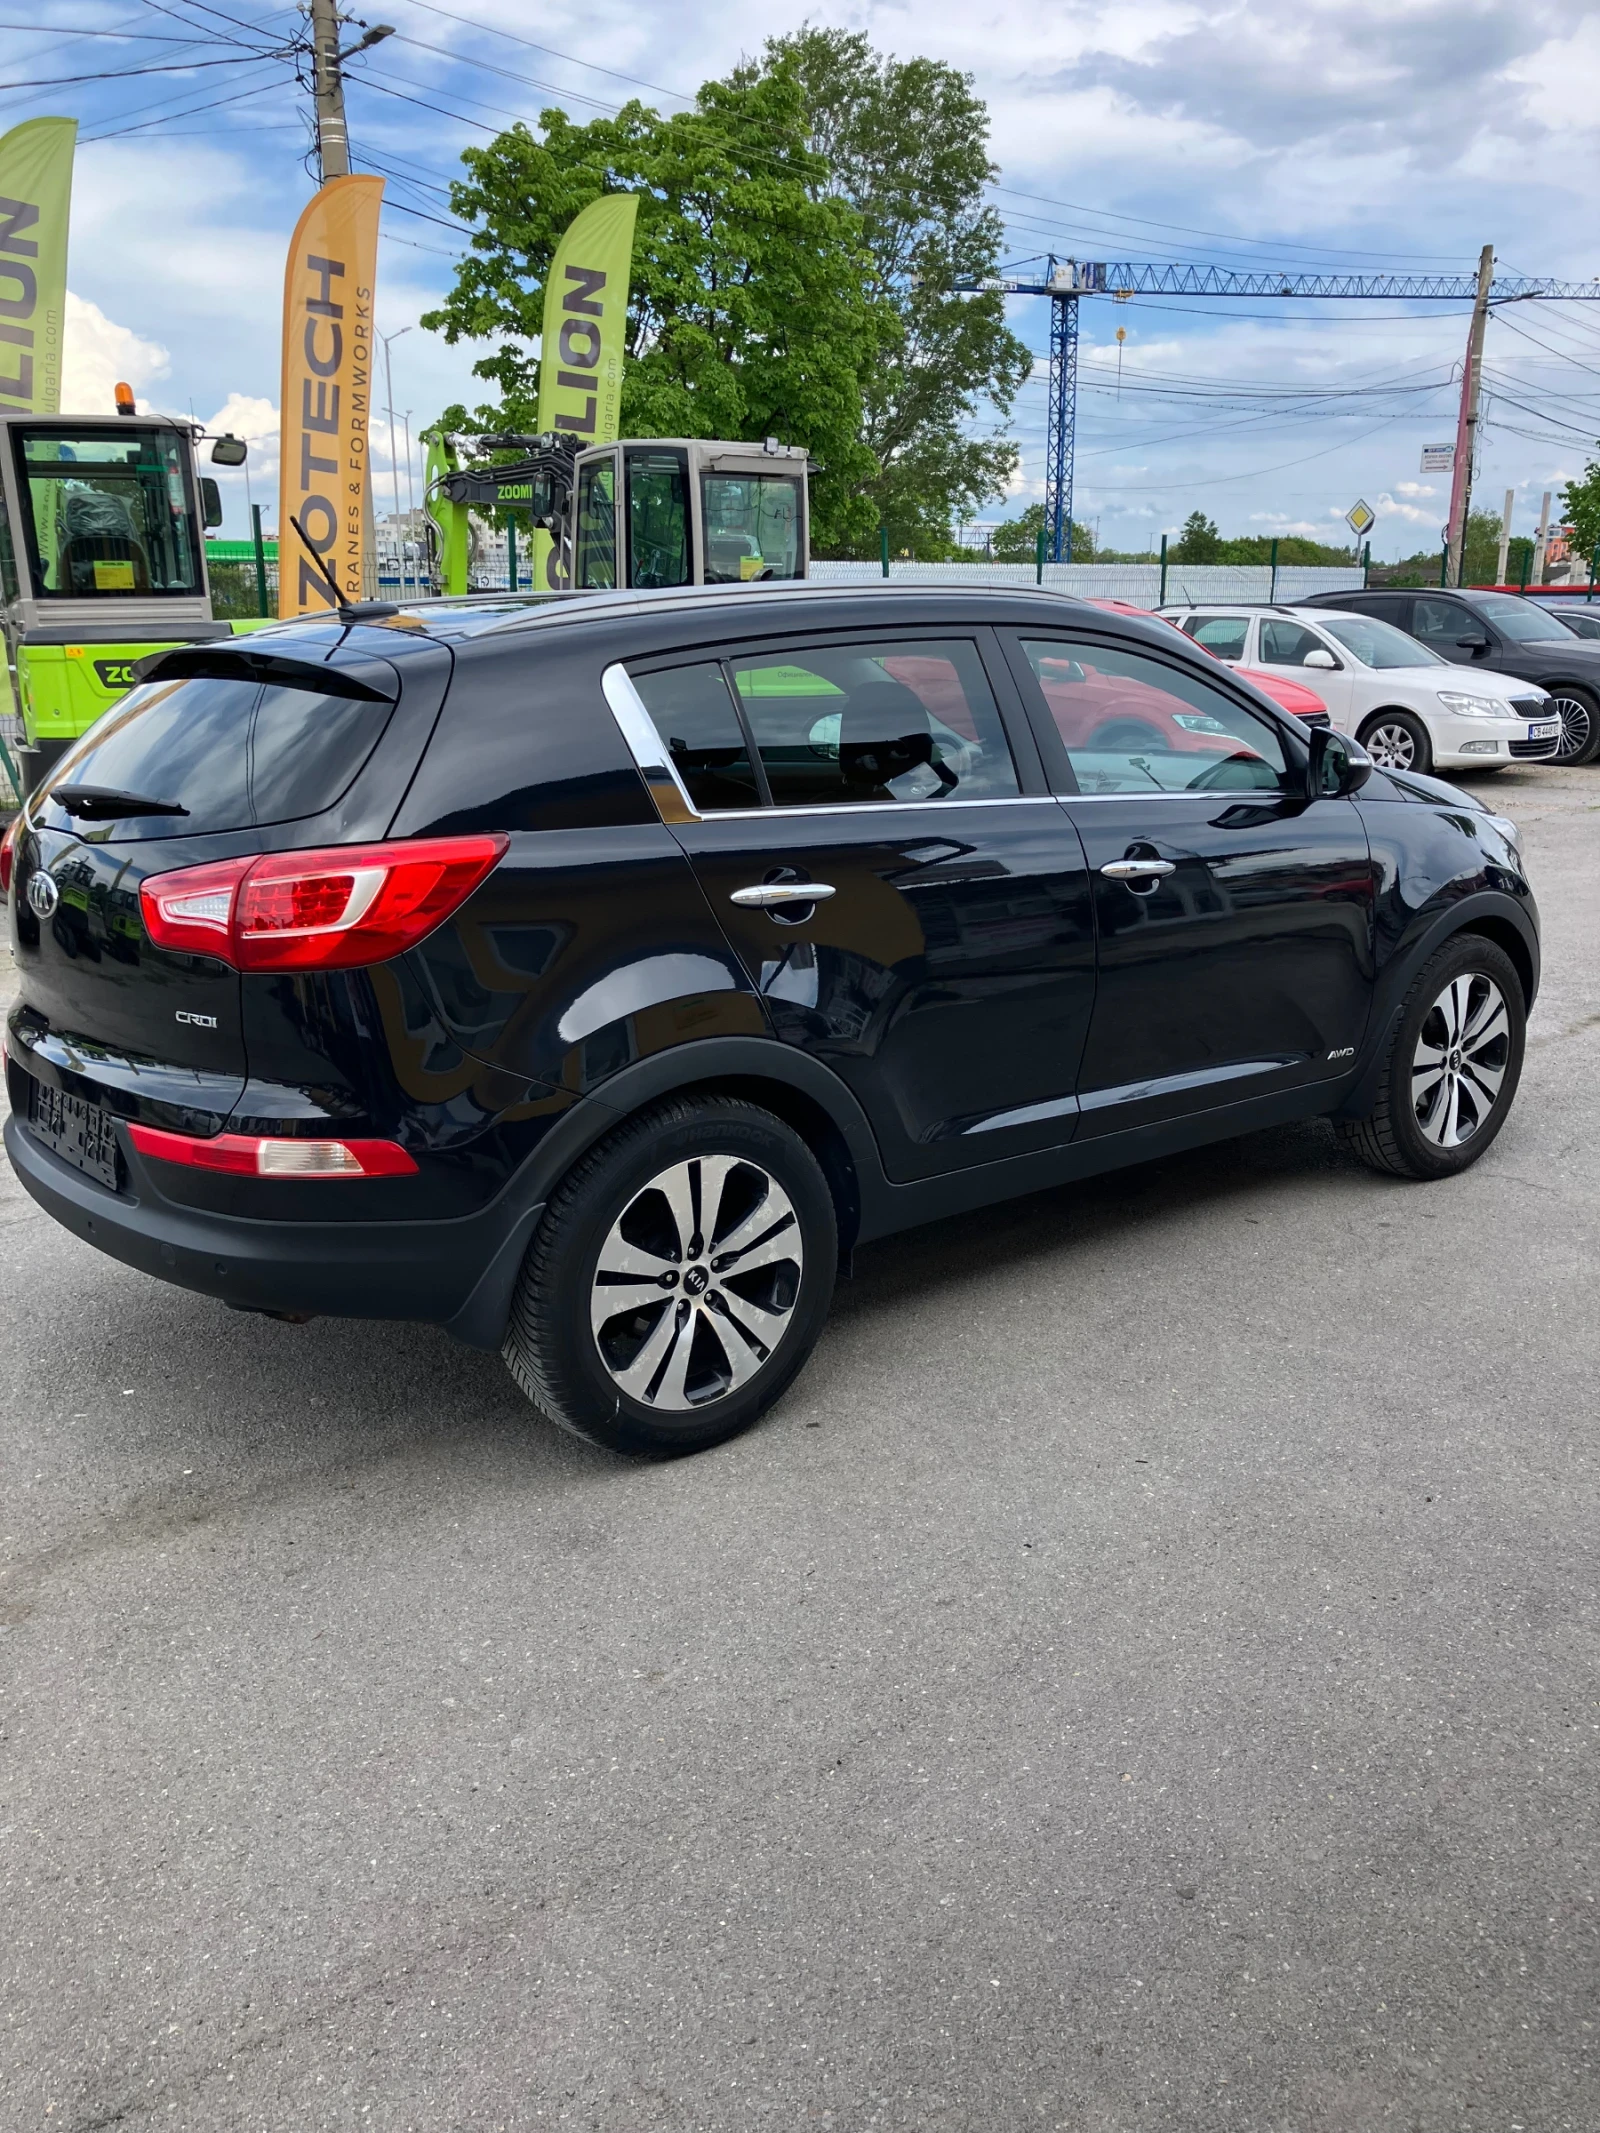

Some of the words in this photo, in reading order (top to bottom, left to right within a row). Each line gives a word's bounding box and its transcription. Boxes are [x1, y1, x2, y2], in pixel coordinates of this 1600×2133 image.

[0, 196, 40, 414] LION
[554, 265, 607, 434] LION
[350, 286, 371, 470] FORMWORKS
[603, 358, 617, 443] ulgaria.com
[299, 254, 345, 609] ZOTECH
[349, 482, 361, 495] &
[347, 506, 360, 602] RANES
[105, 666, 135, 683] ZO
[1326, 1047, 1355, 1060] AWD
[687, 1270, 706, 1291] KIA
